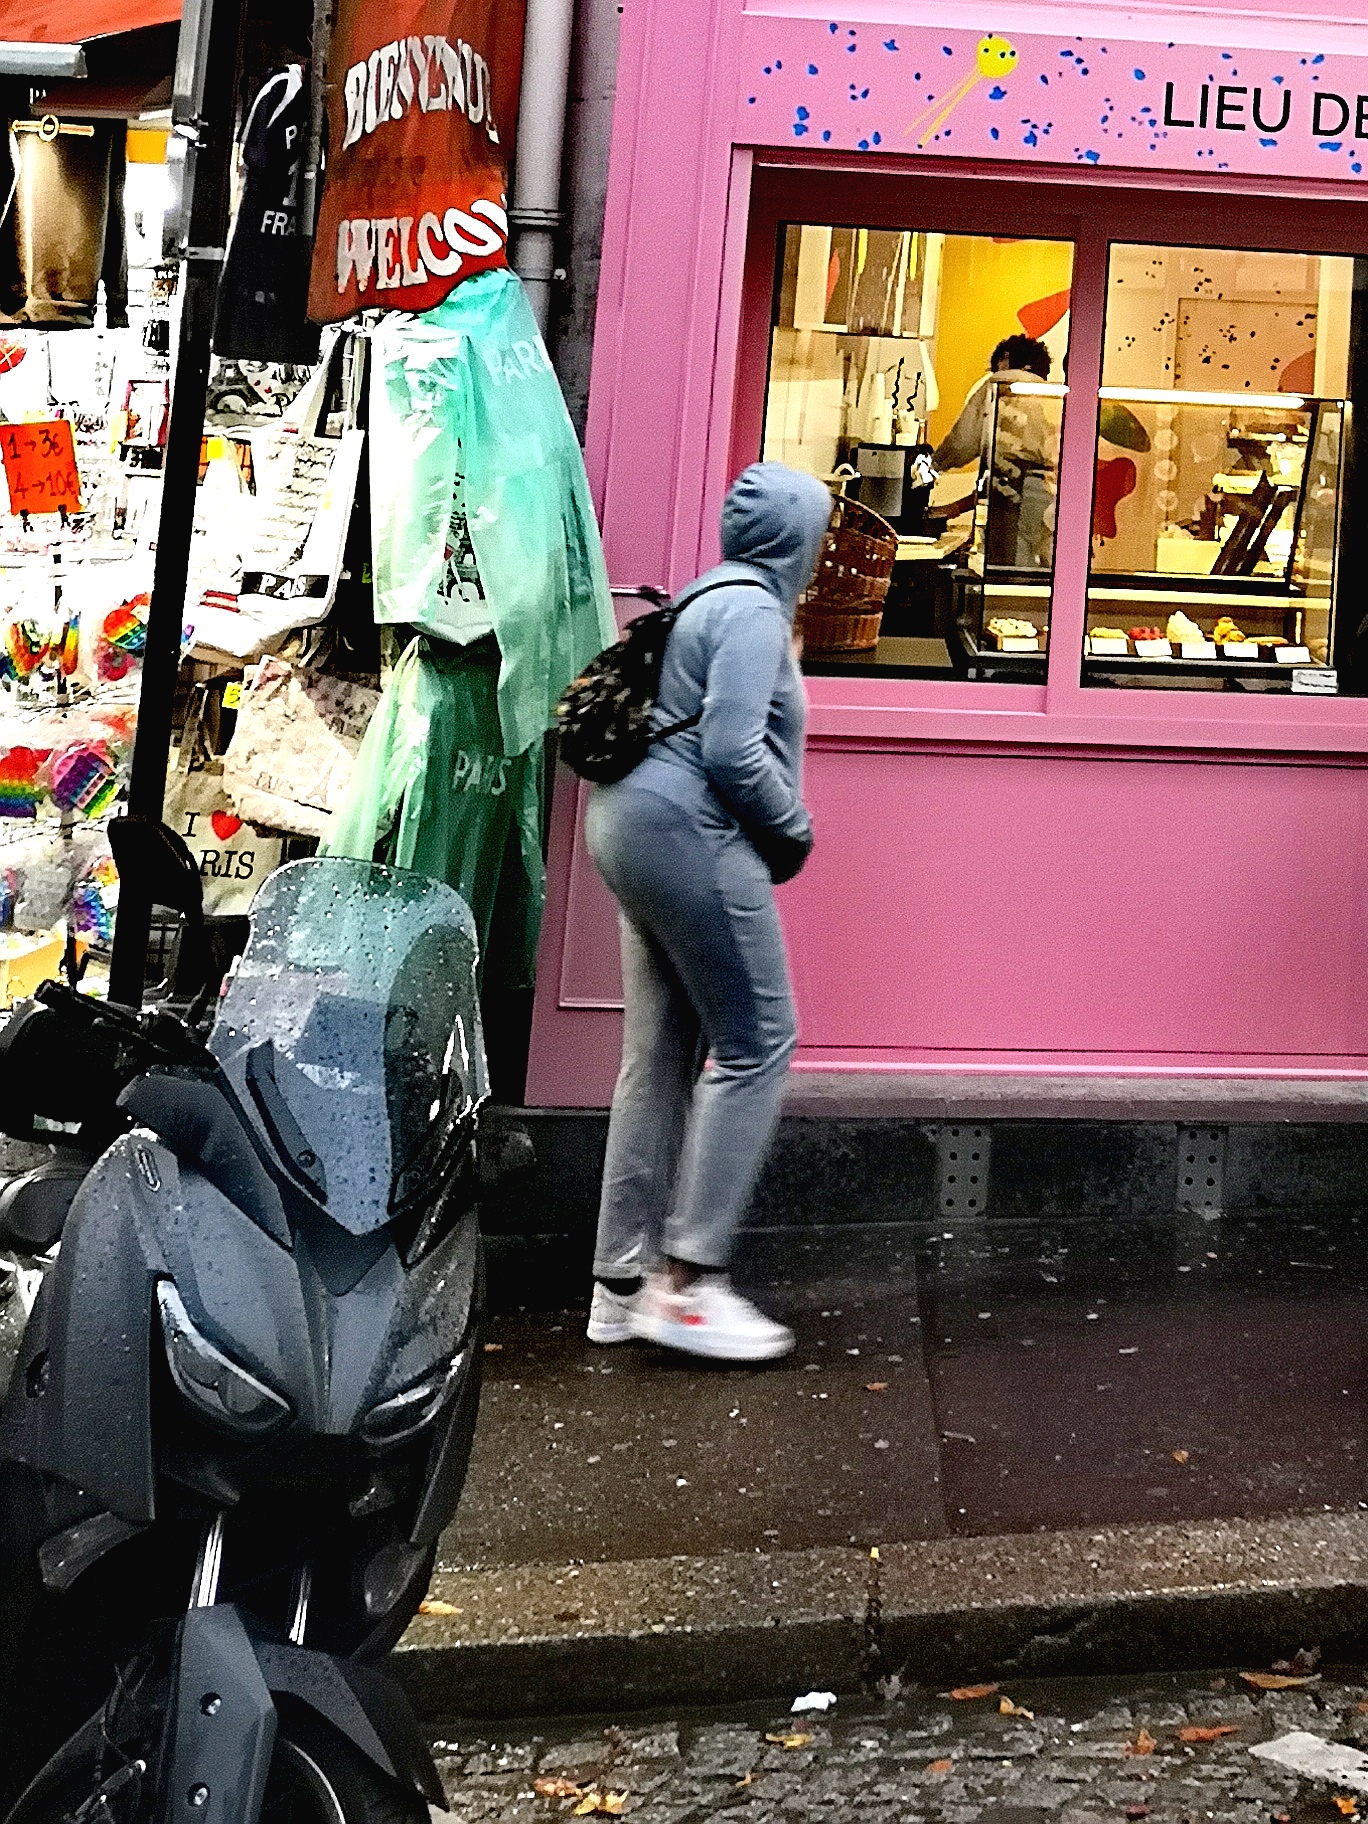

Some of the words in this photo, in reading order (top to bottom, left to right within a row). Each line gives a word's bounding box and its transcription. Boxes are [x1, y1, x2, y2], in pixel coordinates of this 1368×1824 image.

[1163, 81, 1292, 134] LIEU
[181, 810, 202, 839] I
[199, 848, 256, 880] RIS
